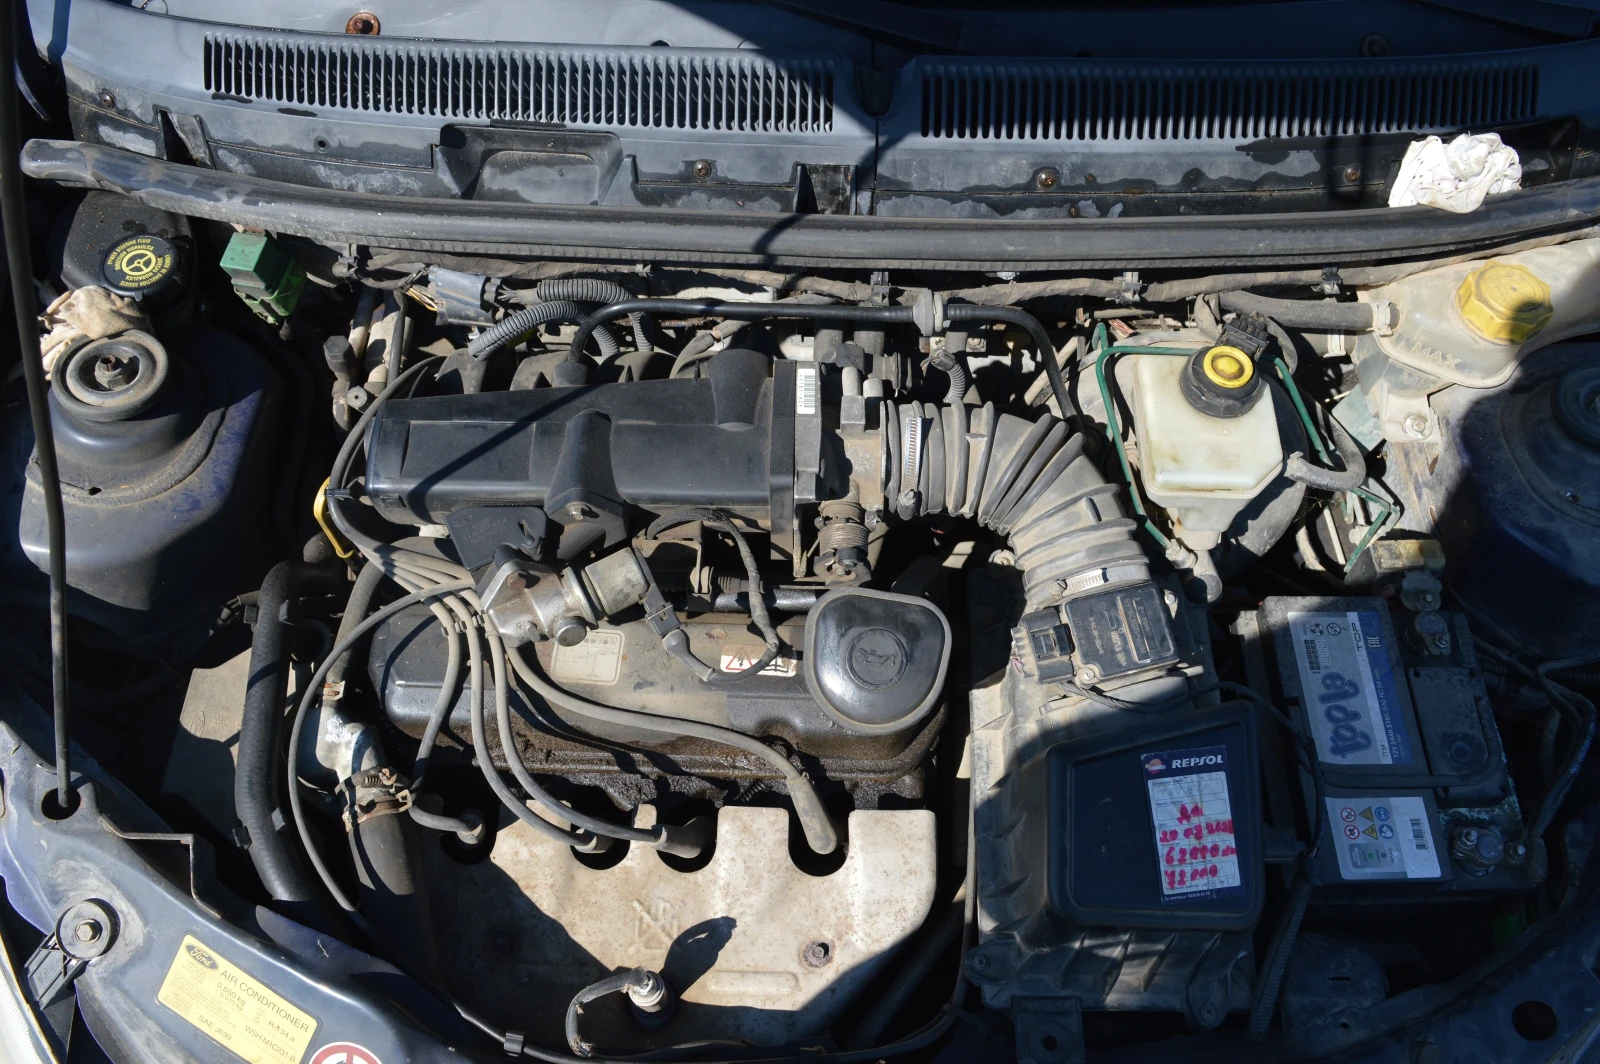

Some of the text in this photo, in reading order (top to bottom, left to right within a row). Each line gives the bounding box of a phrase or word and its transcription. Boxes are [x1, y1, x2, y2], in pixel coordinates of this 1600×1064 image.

[115, 239, 136, 252] STEERING
[1411, 342, 1461, 370] MAX
[1352, 622, 1362, 652] TOP
[1318, 672, 1372, 759] topla
[1387, 729, 1397, 745] 54Ah
[1171, 754, 1224, 769] REPSOL
[190, 946, 213, 967] Ford
[220, 970, 239, 986] AIR
[239, 982, 309, 1033] CONDITIONER
[236, 995, 247, 1007] kg
[198, 1015, 232, 1041] SAE J639
